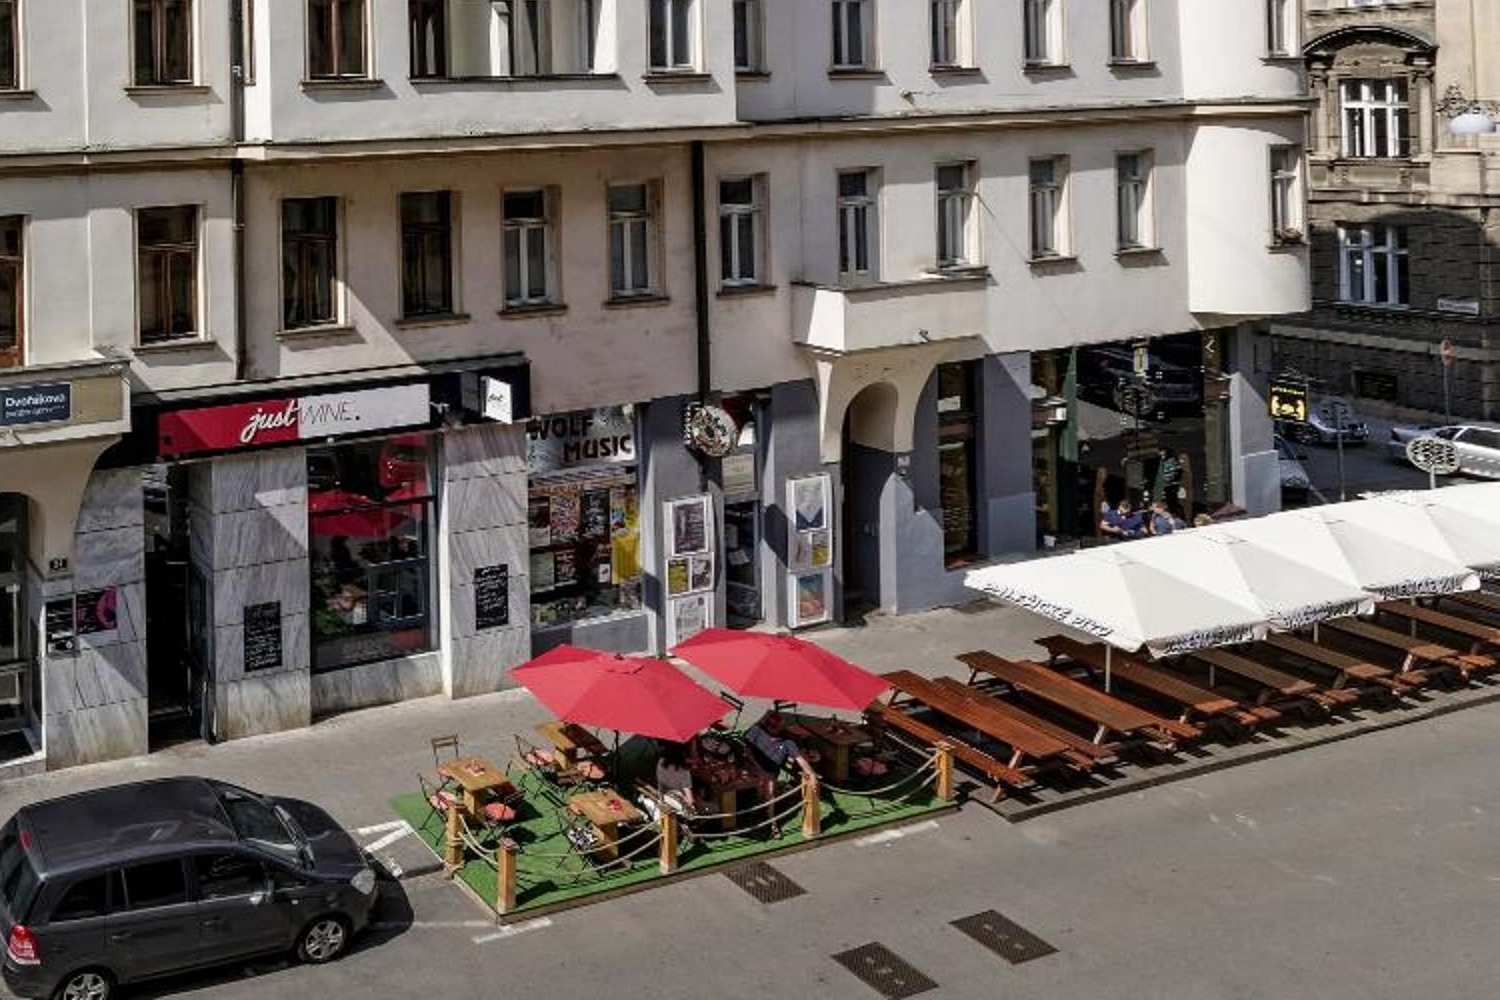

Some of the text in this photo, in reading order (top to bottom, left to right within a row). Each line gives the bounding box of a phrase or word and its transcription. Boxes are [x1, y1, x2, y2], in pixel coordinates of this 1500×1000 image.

[240, 400, 298, 443] just
[528, 415, 594, 441] WOLF
[564, 434, 631, 463] MUSIC
